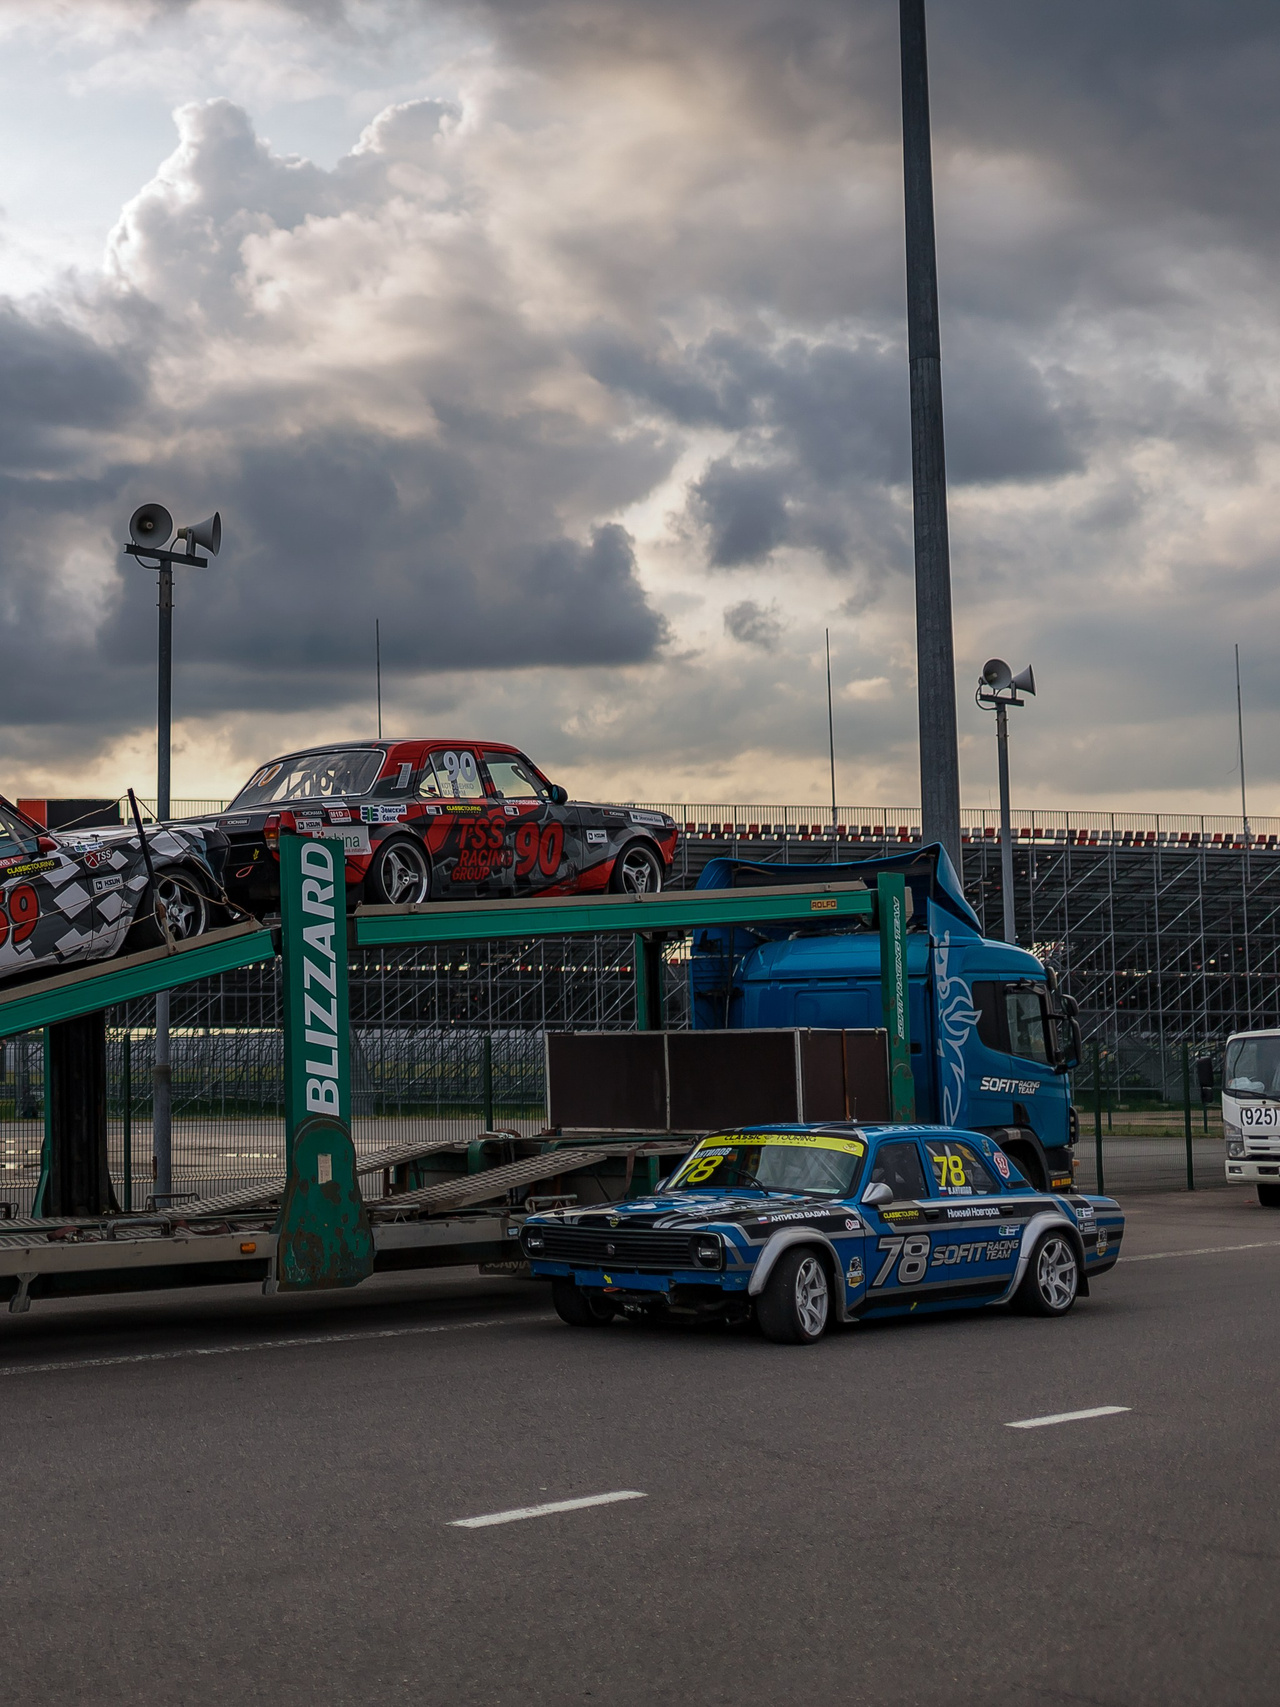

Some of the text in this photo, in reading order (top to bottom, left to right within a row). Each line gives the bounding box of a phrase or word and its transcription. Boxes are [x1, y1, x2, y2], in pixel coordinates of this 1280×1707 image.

[443, 751, 477, 782] 90
[380, 806, 406, 814] Земский
[458, 817, 507, 849] TSS
[96, 849, 111, 862] TSS
[515, 821, 564, 876] 90
[460, 849, 513, 867] RACING
[6, 859, 55, 875] CLASSICTOURING
[452, 867, 490, 881] GROUP
[812, 900, 836, 909] ROLFO
[892, 896, 904, 1040] SOFIT RACING TEAM
[300, 842, 340, 1117] BLIZZARD
[980, 1076, 1019, 1094] SOFIT
[1018, 1080, 1040, 1089] RACING
[1018, 1087, 1036, 1095] TEAM
[1240, 1108, 1278, 1127] (925)
[776, 1133, 817, 1143] TOURING
[677, 1155, 724, 1183] 78
[933, 1155, 966, 1187] 78
[770, 1209, 831, 1222] АНТИПОВ ВАДИМ
[883, 1210, 919, 1219] CLASSICTOURING
[947, 1206, 1000, 1219] Нижний Новгород
[987, 1239, 1020, 1251] RACING
[871, 1234, 931, 1287] 78
[930, 1242, 988, 1267] SOFIT
[986, 1249, 1012, 1261] TEAM
